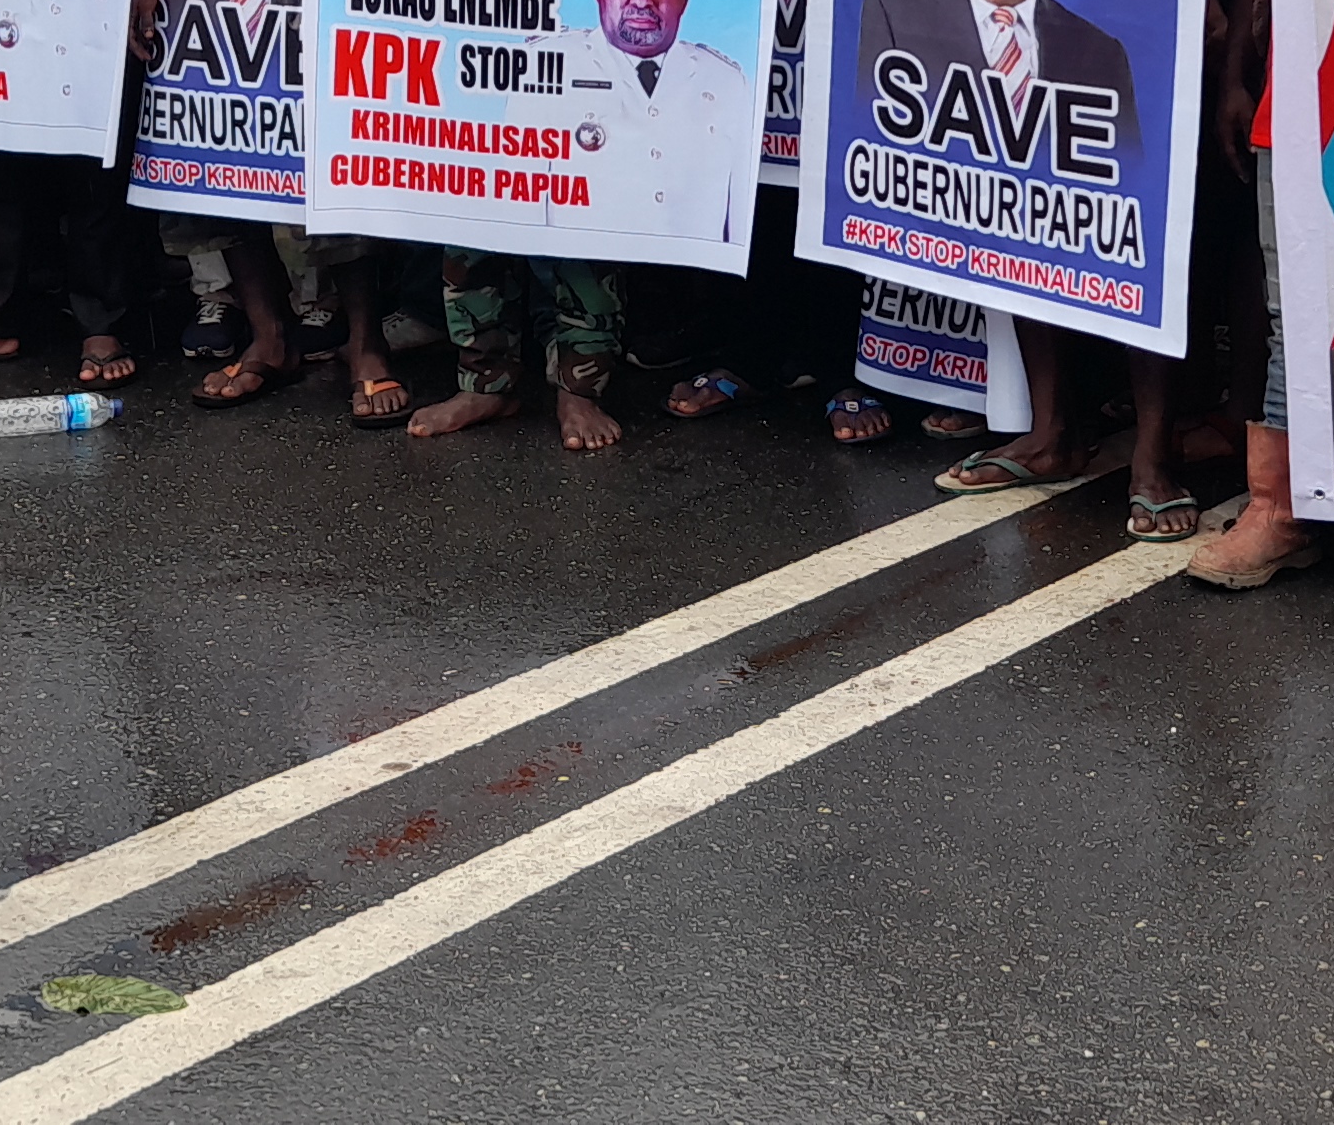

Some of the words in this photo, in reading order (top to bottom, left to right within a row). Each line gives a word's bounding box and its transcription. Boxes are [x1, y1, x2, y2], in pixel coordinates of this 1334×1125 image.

[334, 28, 441, 106] KPK
[460, 43, 565, 95] STOP..!!!
[140, 88, 251, 148] BERNUR
[260, 102, 305, 153] PA
[351, 108, 571, 160] KRIMINALISASI
[876, 56, 1114, 180] SAVE
[148, 158, 201, 185] STOP
[330, 154, 486, 198] GUBERNUR
[494, 169, 590, 206] PAPUA
[849, 144, 1019, 235] GUBERNUR
[1029, 185, 1141, 263] PAPUA
[845, 219, 901, 252] #KPK
[907, 236, 965, 265] STOP
[971, 249, 1143, 312] KRIMINALISASI
[863, 336, 927, 369] STOP
